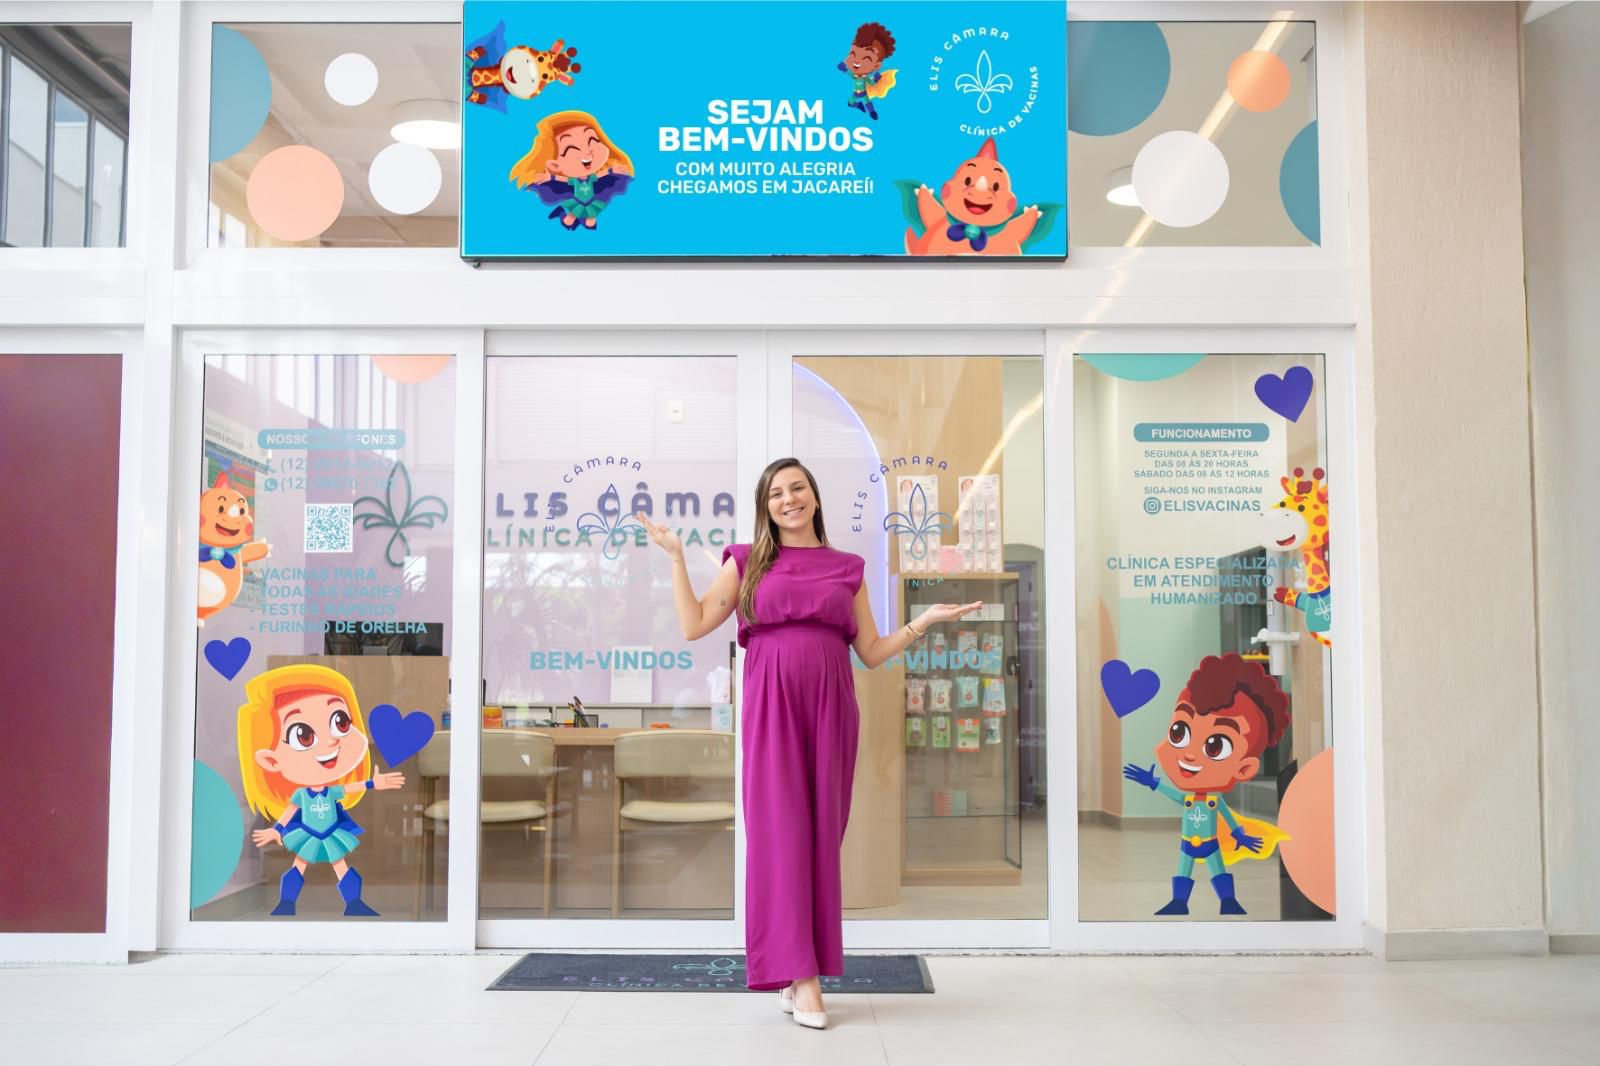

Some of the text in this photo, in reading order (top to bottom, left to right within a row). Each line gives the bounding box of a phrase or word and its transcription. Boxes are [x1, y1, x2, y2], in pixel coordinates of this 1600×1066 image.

[930, 27, 1009, 91] ELIS CÂMARA
[960, 66, 1039, 136] CLÍNICA DE VACINAS
[707, 99, 823, 125] SEJAM
[659, 127, 874, 152] BEM-VINDOS
[675, 161, 856, 176] COM MUITO ALEGRIA
[657, 176, 874, 194] CHEGAMOS EM JACAREÍ!
[266, 434, 319, 445] NOSSO
[1151, 428, 1252, 439] FUNCIONAMENTO
[1144, 450, 1189, 458] SEGUNDA
[1200, 450, 1259, 458] SEXTA-FEIRA
[563, 456, 641, 484] CÂMARA
[1154, 460, 1174, 468] DAS
[1176, 460, 1186, 468] 08
[1204, 460, 1214, 468] 20
[1216, 460, 1249, 468] HORAS
[1175, 470, 1195, 478] DAS
[1197, 470, 1207, 478] 08
[1225, 470, 1235, 478] 12
[1237, 470, 1270, 478] HORAS
[852, 456, 948, 533] ELIS CÂMARA
[1144, 486, 1263, 494] SIGA-NOS NO INSTAGRAM
[496, 482, 735, 517] LIS CÂMA
[1163, 500, 1261, 512] ELISVACINAS
[487, 524, 592, 546] LÍNICA
[611, 527, 648, 546] DE
[1107, 554, 1300, 570] CLÍNICA ESPECIALIZADA
[260, 568, 377, 580] VACINAS PARA
[1133, 575, 1274, 587] EM ATENDIMENTO
[260, 586, 313, 598] TODAS
[318, 586, 338, 598] AS
[1151, 592, 1258, 605] HUMANIZADO
[260, 603, 321, 616] TESTES
[335, 620, 356, 633] DE
[360, 620, 428, 634] ORELHA
[529, 650, 693, 671] BEM-VINDOS
[852, 650, 1002, 671] -VINDOS
